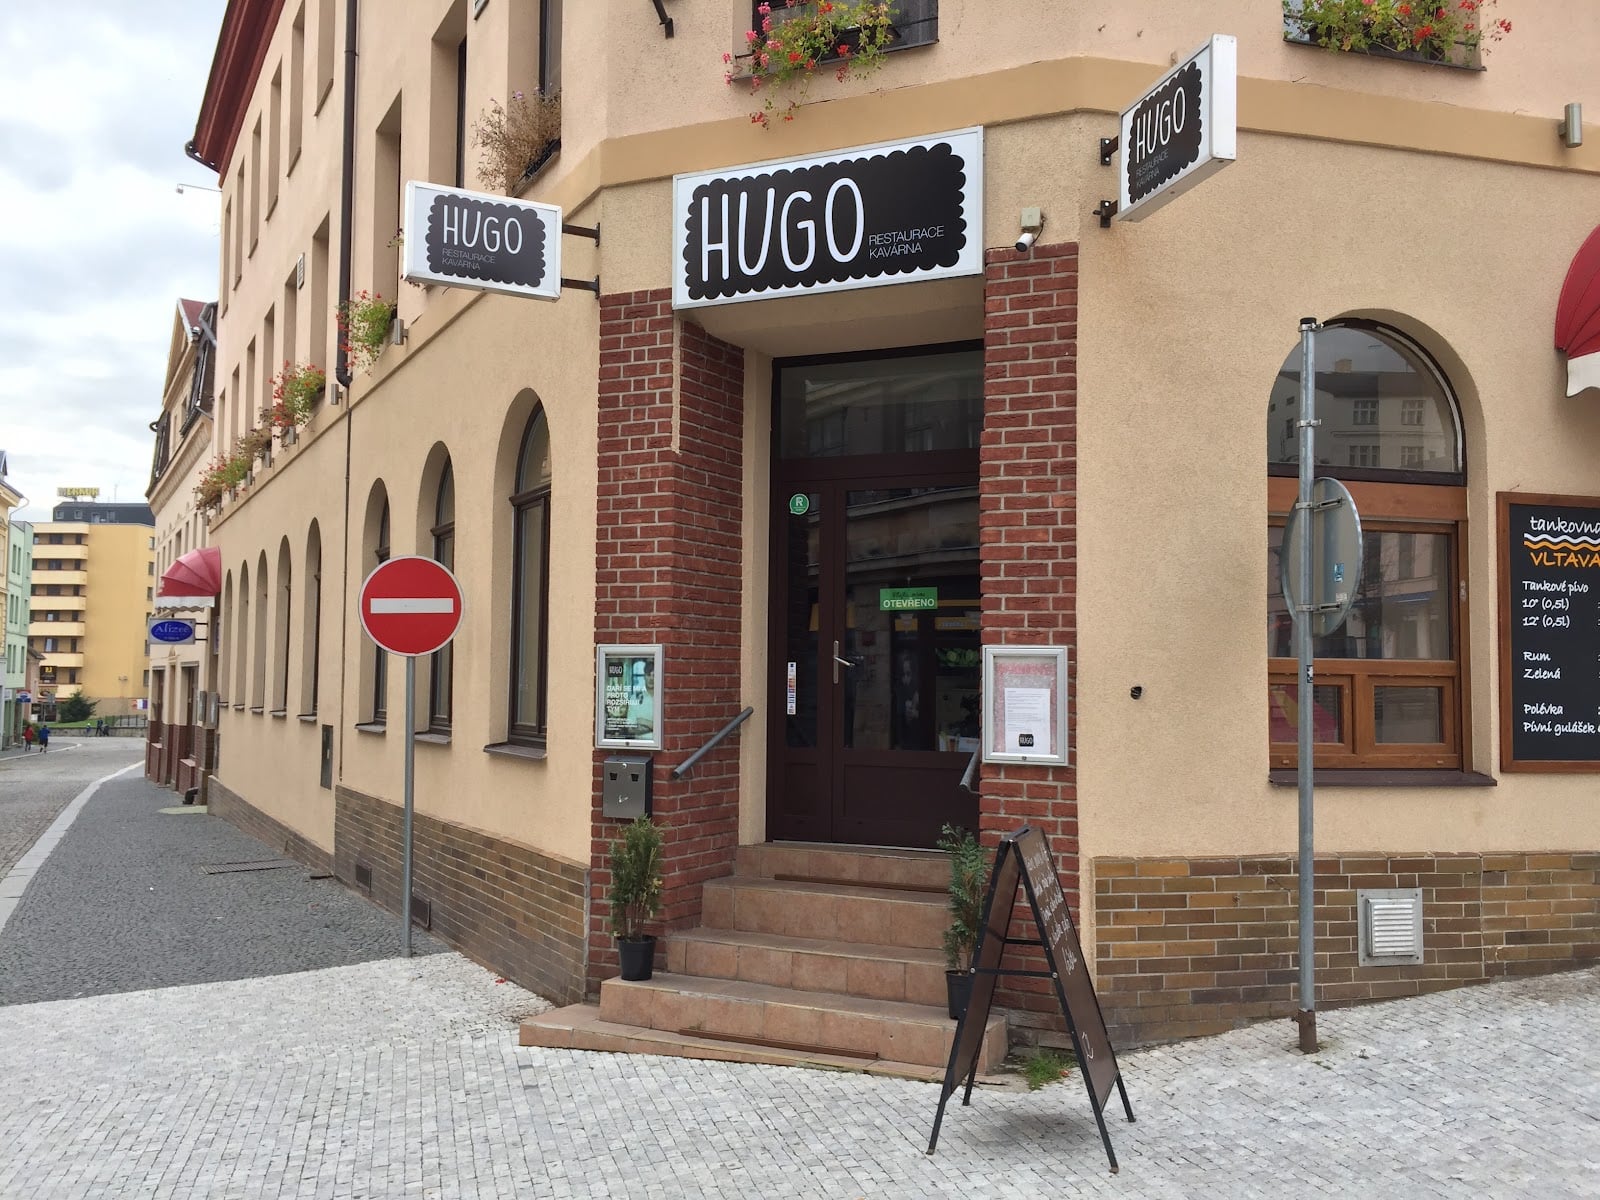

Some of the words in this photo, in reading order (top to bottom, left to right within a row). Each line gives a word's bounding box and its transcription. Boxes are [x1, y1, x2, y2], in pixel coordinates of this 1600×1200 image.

[1136, 86, 1186, 164] HUGO
[442, 204, 524, 255] HUGO
[701, 177, 865, 283] HUGO
[868, 225, 945, 246] RESTAURACE
[442, 247, 496, 264] RESTAURACE
[869, 242, 923, 260] KAVÁRNA
[1530, 551, 1600, 568] VLTAVA
[1521, 580, 1567, 592] Tankové
[883, 597, 935, 608] OTEVŘENO
[1522, 651, 1552, 661] Rum
[1523, 667, 1561, 679] Zelená
[1523, 702, 1564, 715] Polévka
[1553, 720, 1597, 736] gulášek
